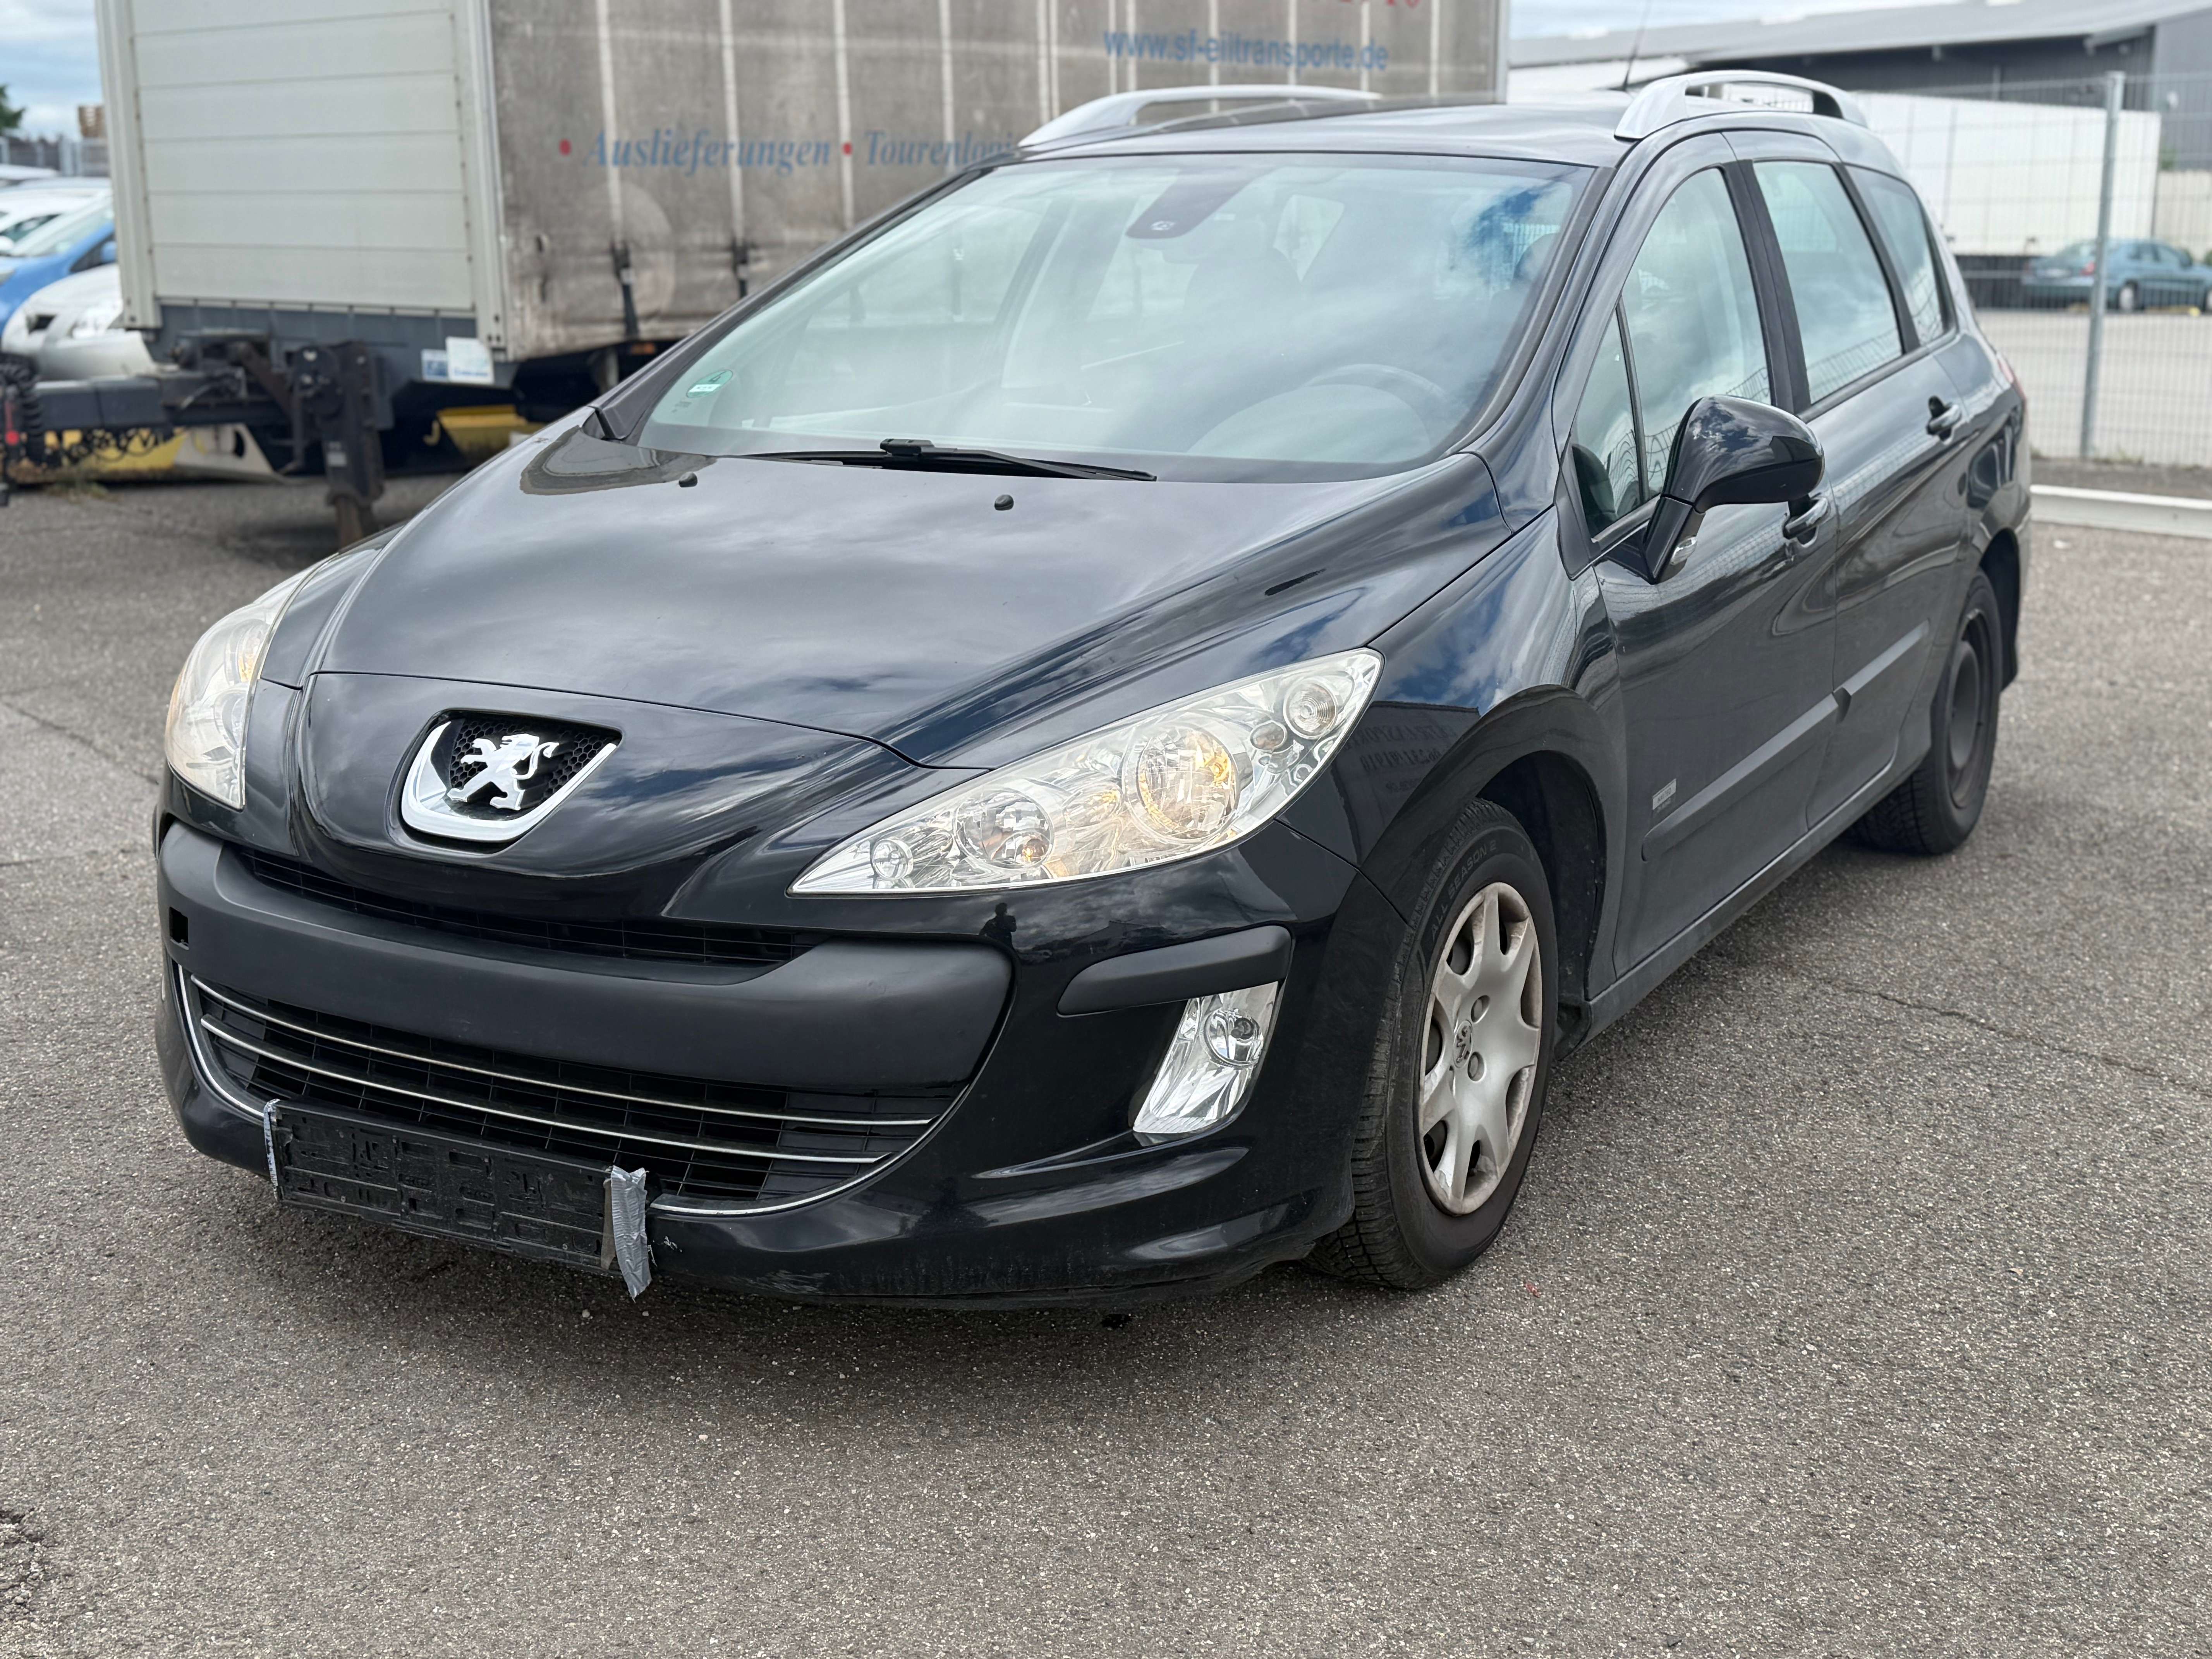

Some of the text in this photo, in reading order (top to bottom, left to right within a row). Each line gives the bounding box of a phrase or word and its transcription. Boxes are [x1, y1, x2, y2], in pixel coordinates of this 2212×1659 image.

[1104, 28, 1388, 73] www.sf-eiltransporte.de
[582, 128, 830, 177] Auslieferungen
[1432, 839, 1497, 943] ALL SEASON 2
